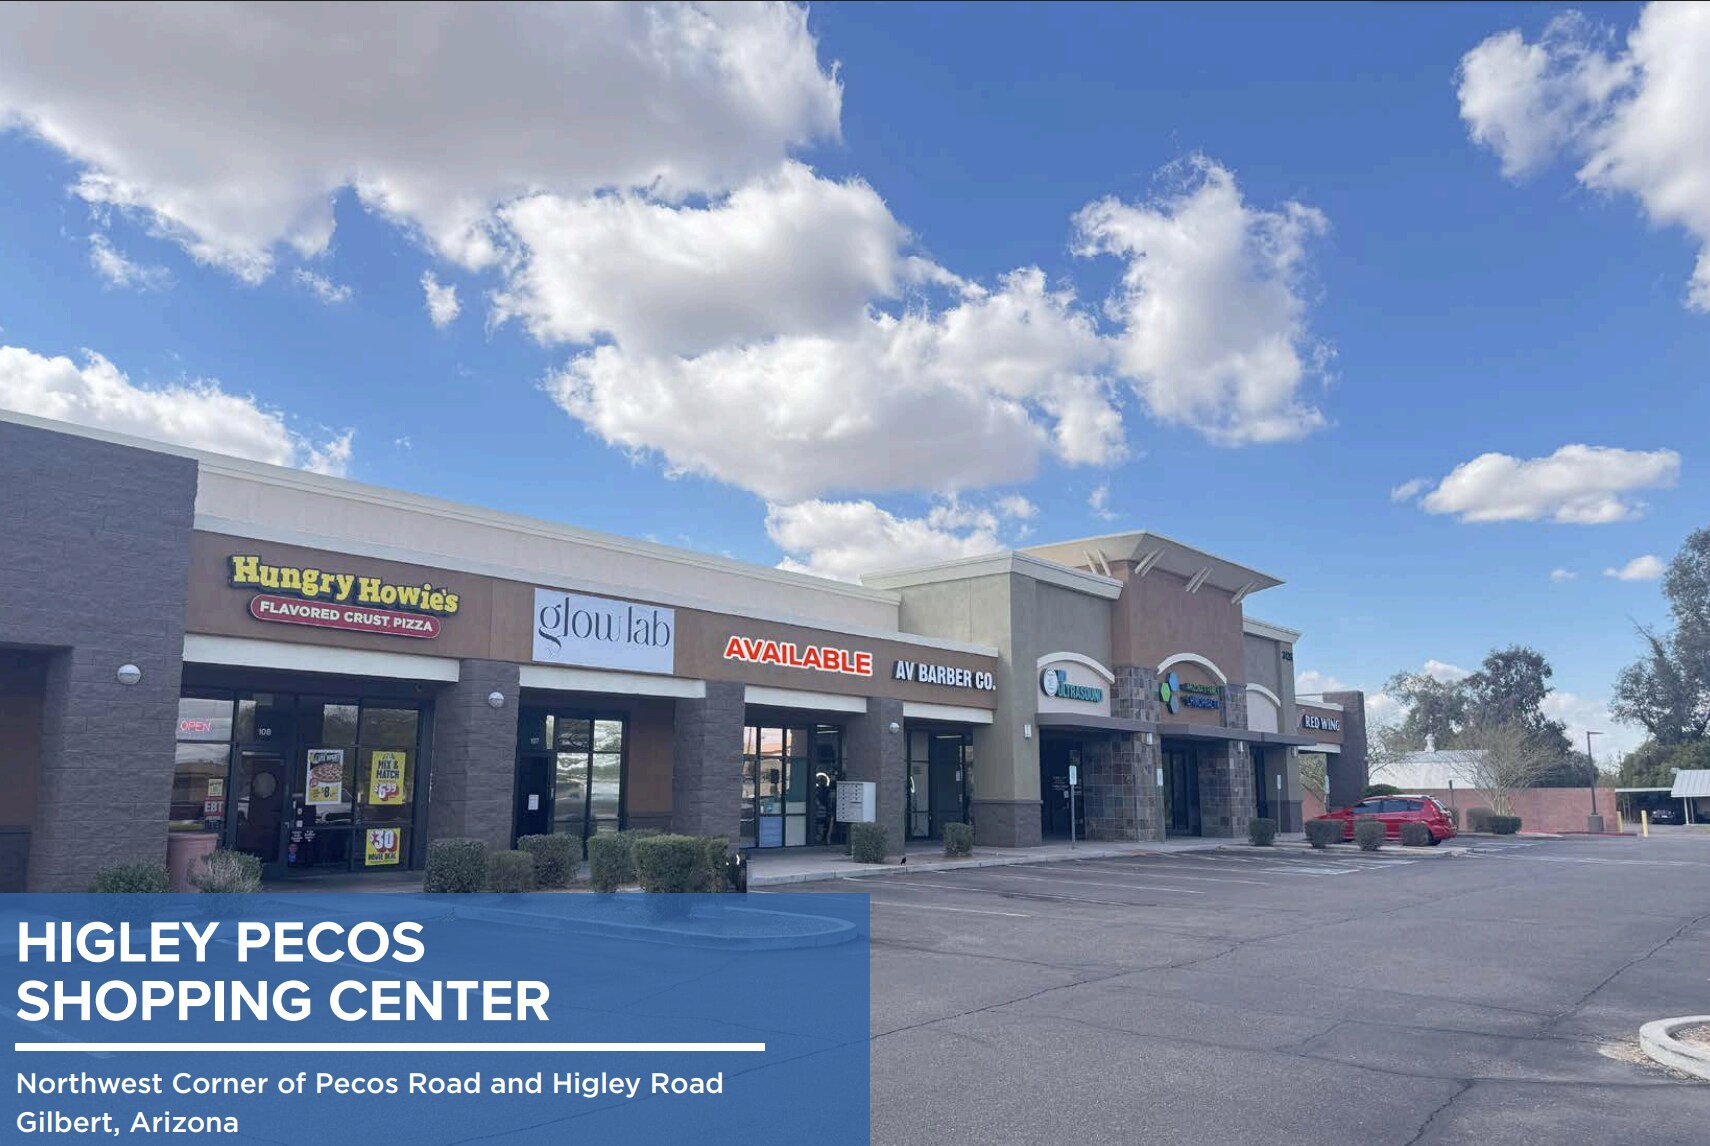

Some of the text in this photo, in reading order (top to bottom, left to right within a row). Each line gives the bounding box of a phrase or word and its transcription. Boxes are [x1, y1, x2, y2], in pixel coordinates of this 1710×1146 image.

[233, 556, 459, 613] Hungry Howie's
[259, 600, 433, 632] FLAVORED CRUST PIZZA
[538, 596, 670, 651] glow lab
[896, 660, 997, 691] AV BARBER CO.
[180, 719, 212, 733] OPEN
[258, 727, 272, 736] 108
[1305, 714, 1340, 732] RED WING
[378, 760, 393, 769] MIX
[376, 769, 400, 779] MATCH
[204, 800, 225, 813] EBT
[370, 829, 394, 850] $30
